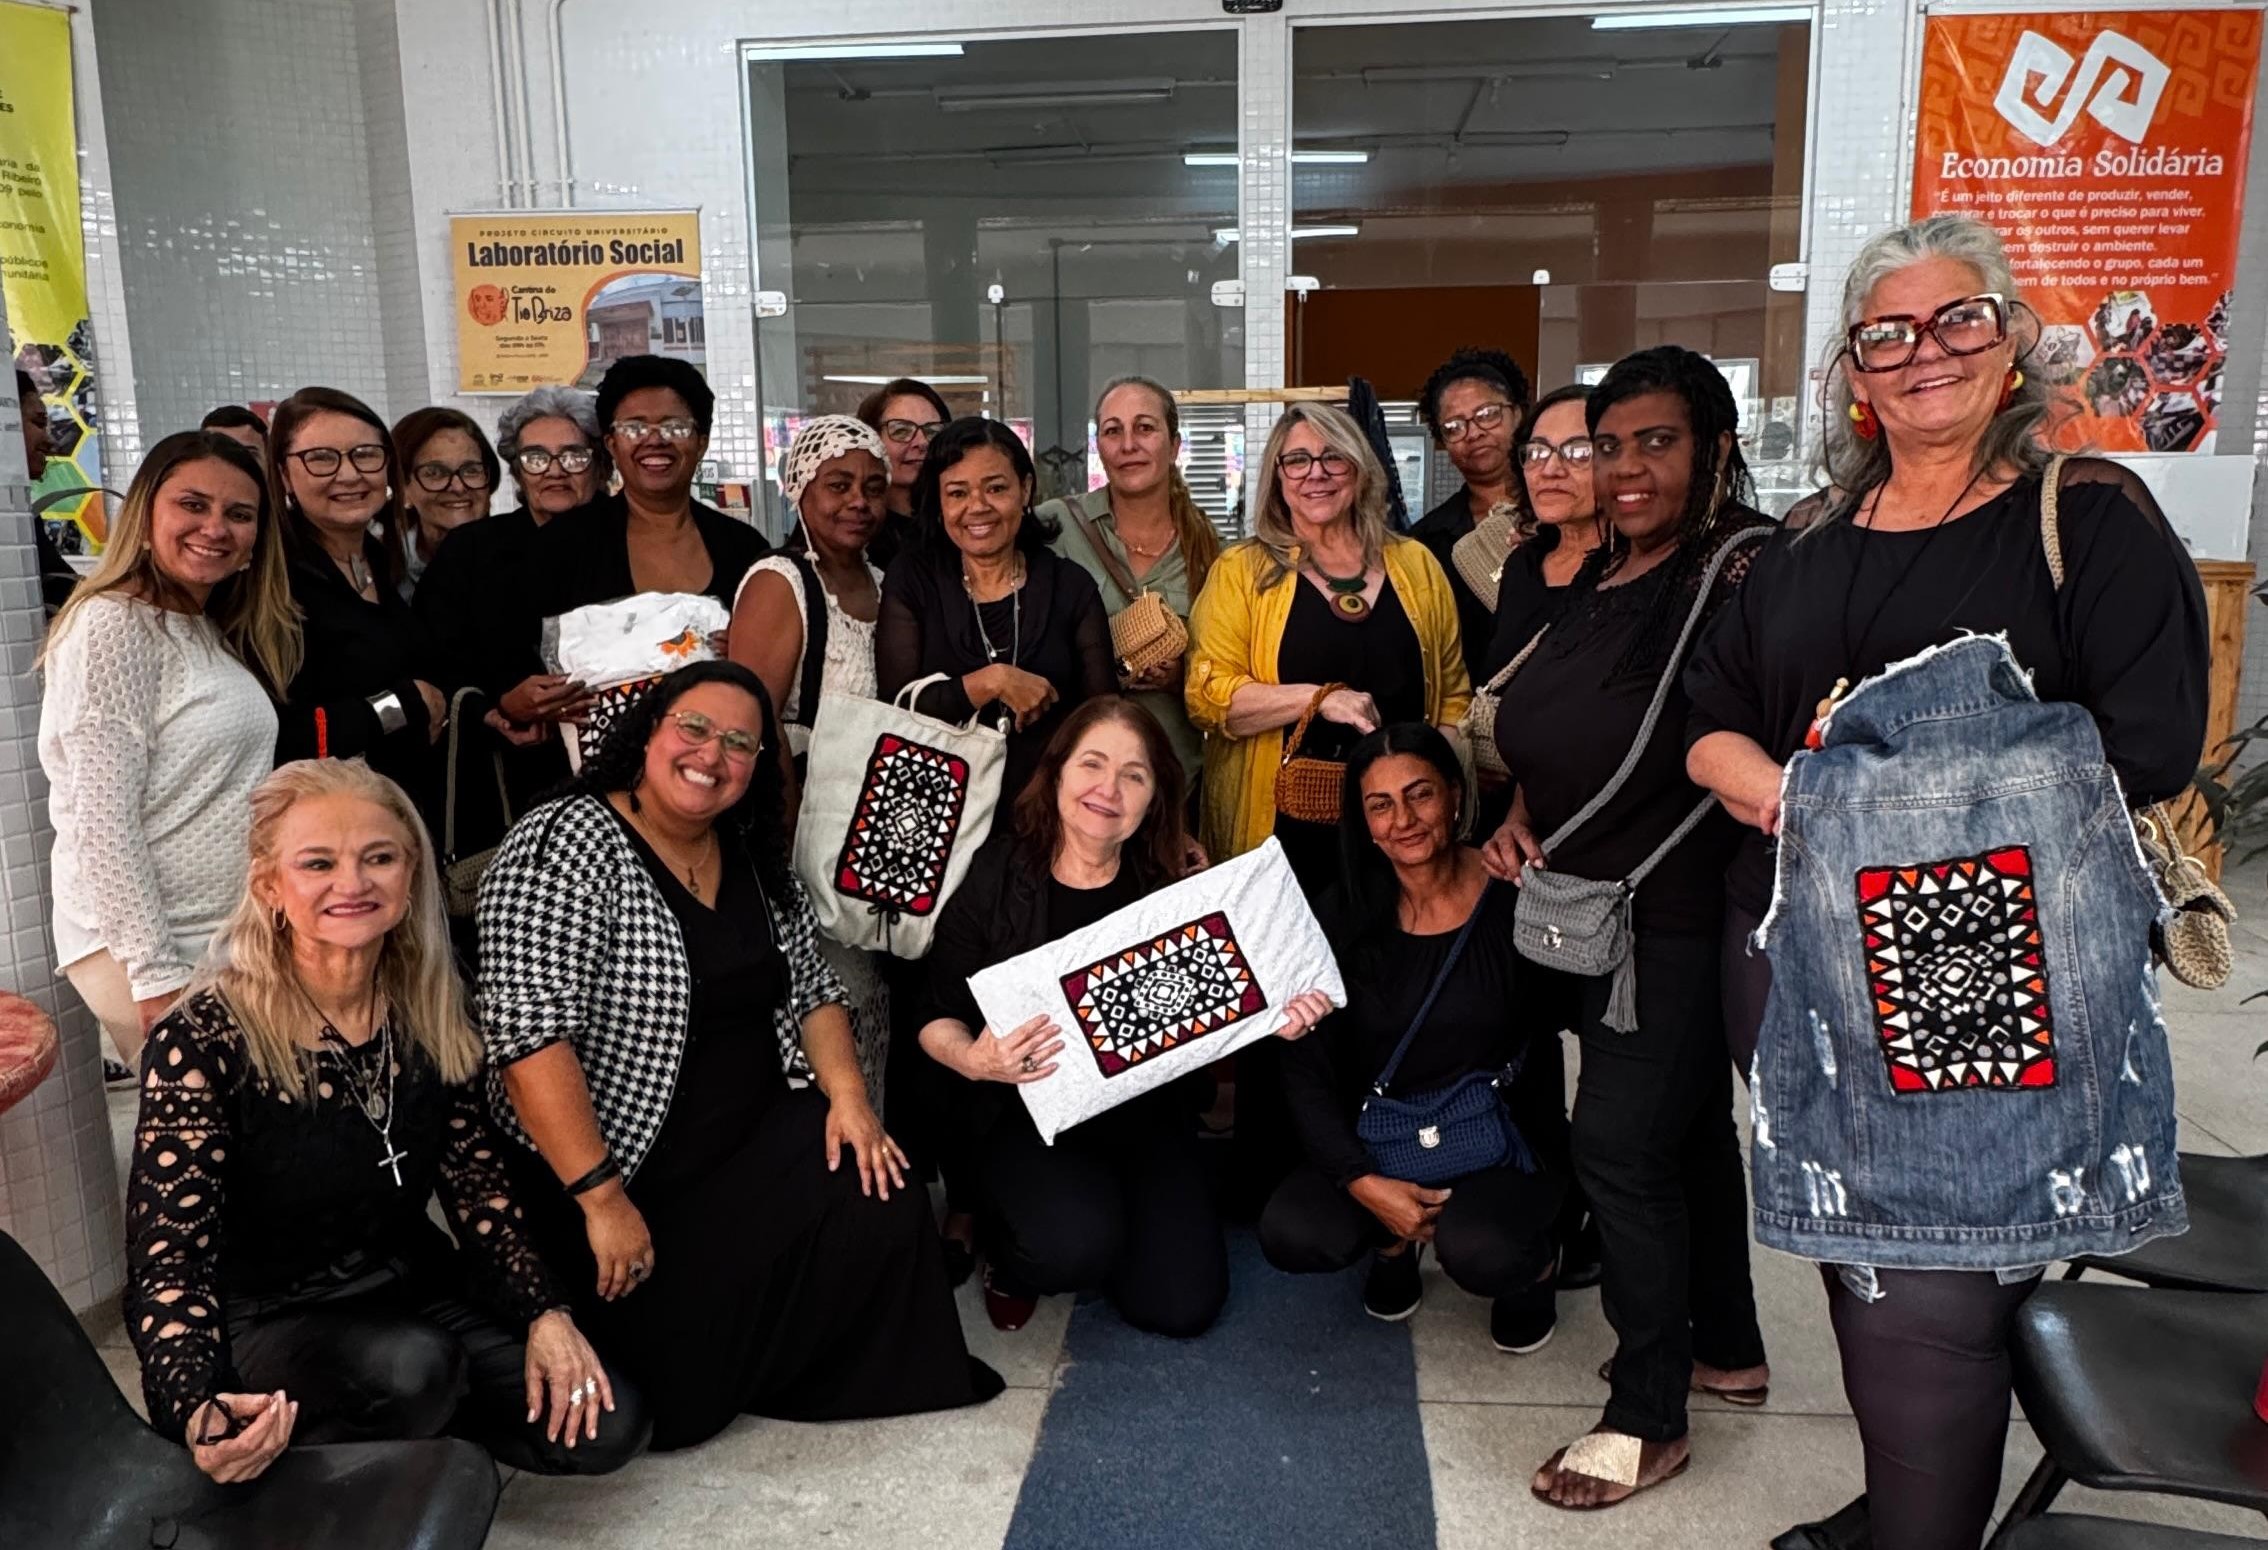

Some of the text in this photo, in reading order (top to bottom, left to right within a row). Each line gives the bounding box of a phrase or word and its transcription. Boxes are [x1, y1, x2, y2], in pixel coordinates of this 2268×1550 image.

[1941, 147, 2223, 178] Economia Solidária
[2, 170, 42, 186] Ribeiro
[1952, 192, 1973, 202] um
[1975, 190, 2002, 204] jeito
[2006, 190, 2065, 202] diferente
[2068, 190, 2084, 201] de
[2087, 188, 2143, 203] produzir,
[2146, 188, 2193, 202] vender,
[1987, 209, 1996, 219] e
[1998, 208, 2037, 219] trocar
[2040, 208, 2049, 218] o
[2052, 208, 2076, 221] que
[2079, 206, 2088, 218] é
[2091, 206, 2137, 220] preciso
[2140, 207, 2169, 219] para
[586, 227, 669, 236] UNIVERSITÁRIO
[2016, 226, 2033, 237] os
[2034, 225, 2079, 237] outros,
[2082, 225, 2110, 235] sem
[2113, 225, 2156, 237] querer
[2158, 223, 2190, 235] levar
[467, 238, 684, 267] Laboratório Social
[2028, 242, 2078, 253] destruir
[2081, 243, 2090, 252] o
[2093, 241, 2157, 252] ambiente.
[2009, 257, 2204, 271] fortalecendo o grupo, cada um
[2041, 275, 2058, 286] de
[2060, 274, 2097, 287] todos
[2100, 275, 2108, 285] e
[2112, 275, 2128, 286] no
[2130, 273, 2177, 287] próprio
[511, 285, 557, 294] Cantina do
[511, 296, 531, 324] Tio
